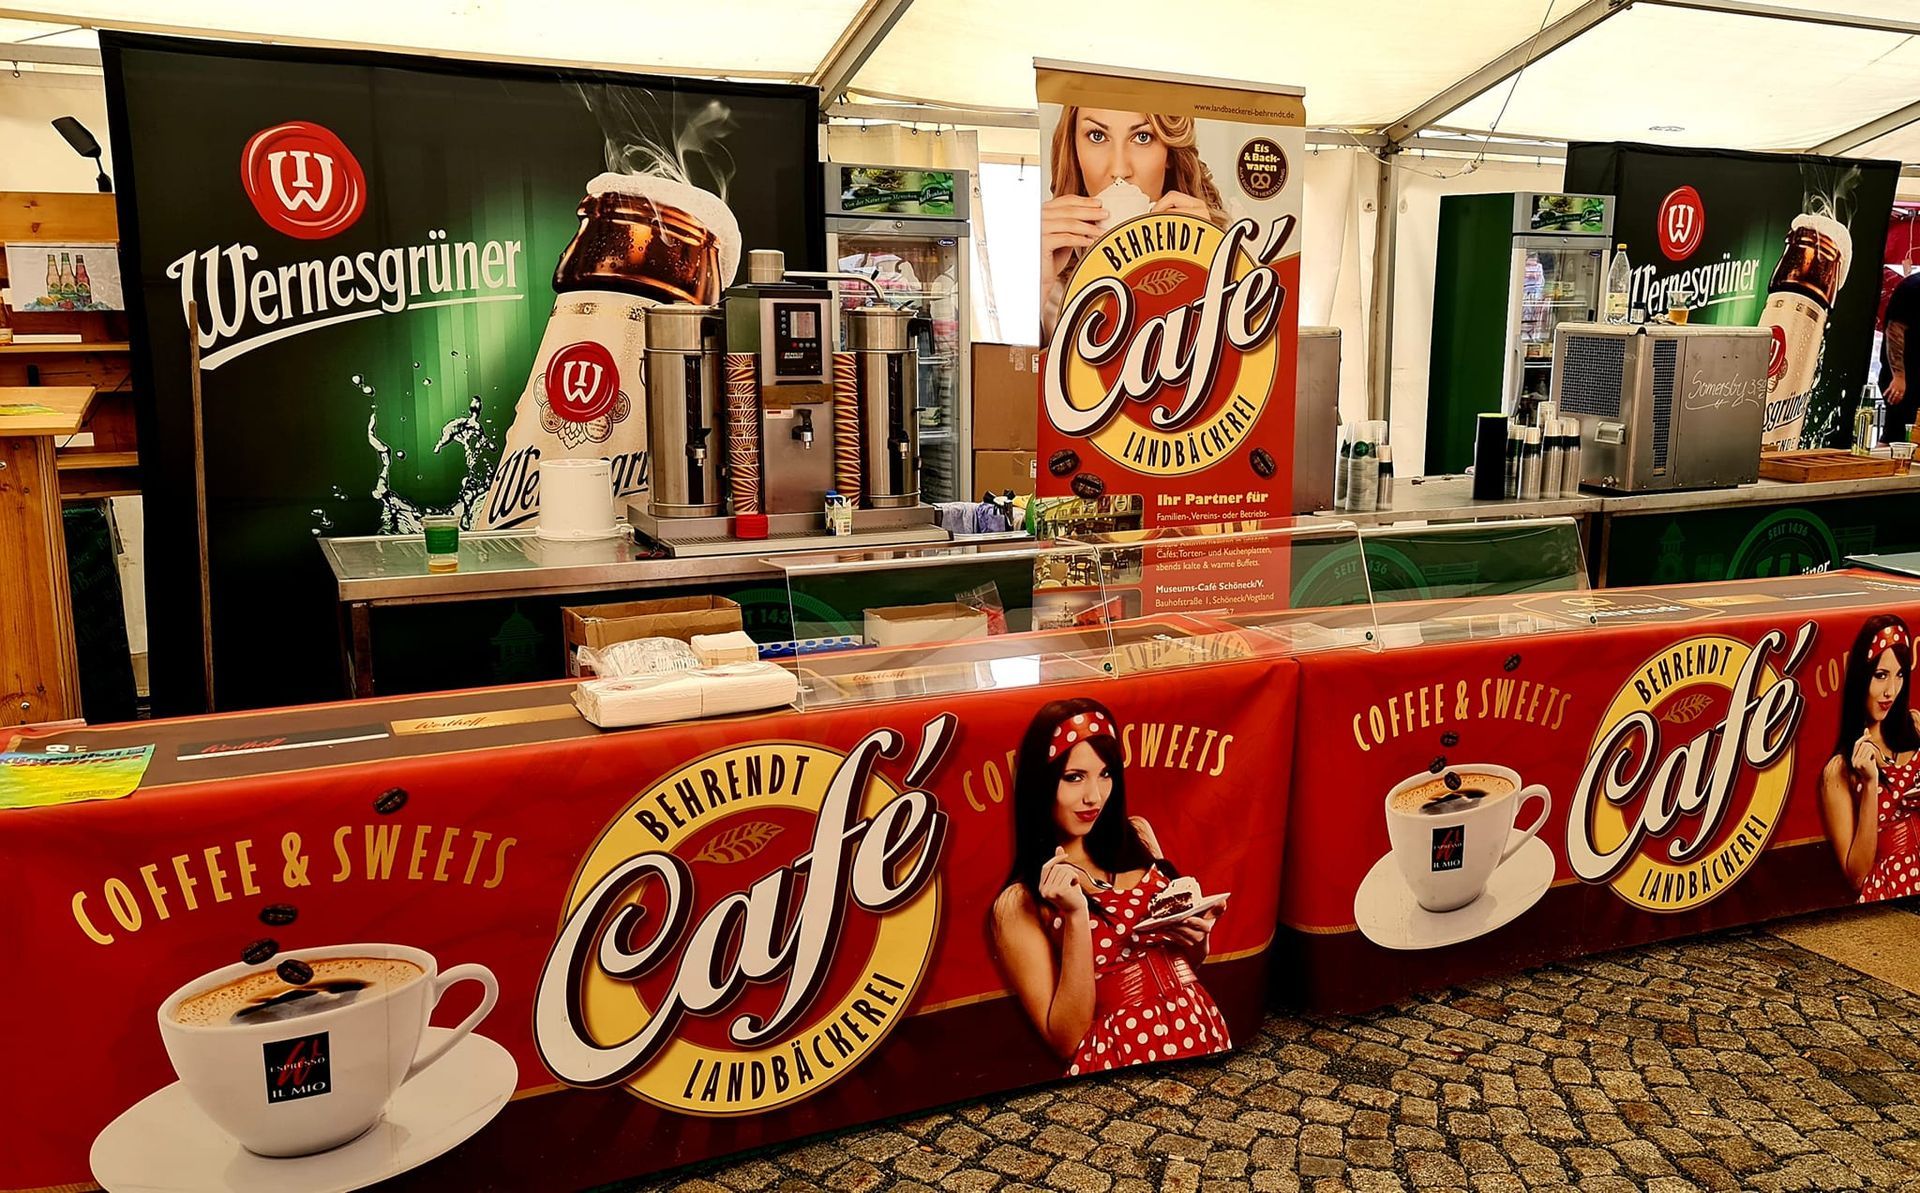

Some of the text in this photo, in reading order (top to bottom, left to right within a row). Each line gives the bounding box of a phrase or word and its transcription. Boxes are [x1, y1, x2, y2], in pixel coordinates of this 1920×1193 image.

[1193, 103, 1295, 119] www.landbaeckerei-behrendt.de
[1243, 152, 1281, 163] & Back-
[1254, 143, 1269, 153] Eis
[1245, 162, 1277, 172] waren
[1101, 221, 1206, 272] BEHRENDT
[166, 229, 521, 349] Wernesgrüner
[1043, 213, 1297, 438] Café
[1687, 370, 1747, 408] Somersby
[1123, 394, 1256, 468] LANDBÄCKEREI
[1156, 491, 1269, 506] Ihr Partner für
[1221, 510, 1239, 519] oder
[1240, 508, 1270, 519] Betriebs-
[1768, 522, 1809, 541] SEIT 1436
[1179, 549, 1206, 558] Torten-
[1208, 548, 1222, 557] und
[1155, 562, 1181, 571] abends
[1183, 561, 1201, 570] kalte
[1202, 561, 1209, 569] &
[1210, 560, 1235, 569] warme
[1334, 560, 1357, 579] SEIT
[1155, 579, 1264, 594] Museums-Café Schöneck/V.
[1155, 597, 1203, 608] Bauhofstraße
[1212, 592, 1275, 605] Schöneck/Vogtland
[1634, 643, 1733, 705] BEHRENDT
[415, 716, 487, 730] Westhoff
[1353, 678, 1572, 752] COFFEE & SWEETS
[201, 737, 287, 754] Westhoff
[1122, 723, 1234, 777] SWEETS
[1566, 618, 1819, 886] Café
[634, 753, 810, 843] BEHRENDT
[1638, 813, 1768, 903] LANDBÄCKEREI
[71, 823, 518, 945] COFFEE & SWEETS
[533, 711, 958, 1090] Café
[683, 972, 906, 1103] LANDBÄCKEREI
[272, 1081, 326, 1098] IL MIO
